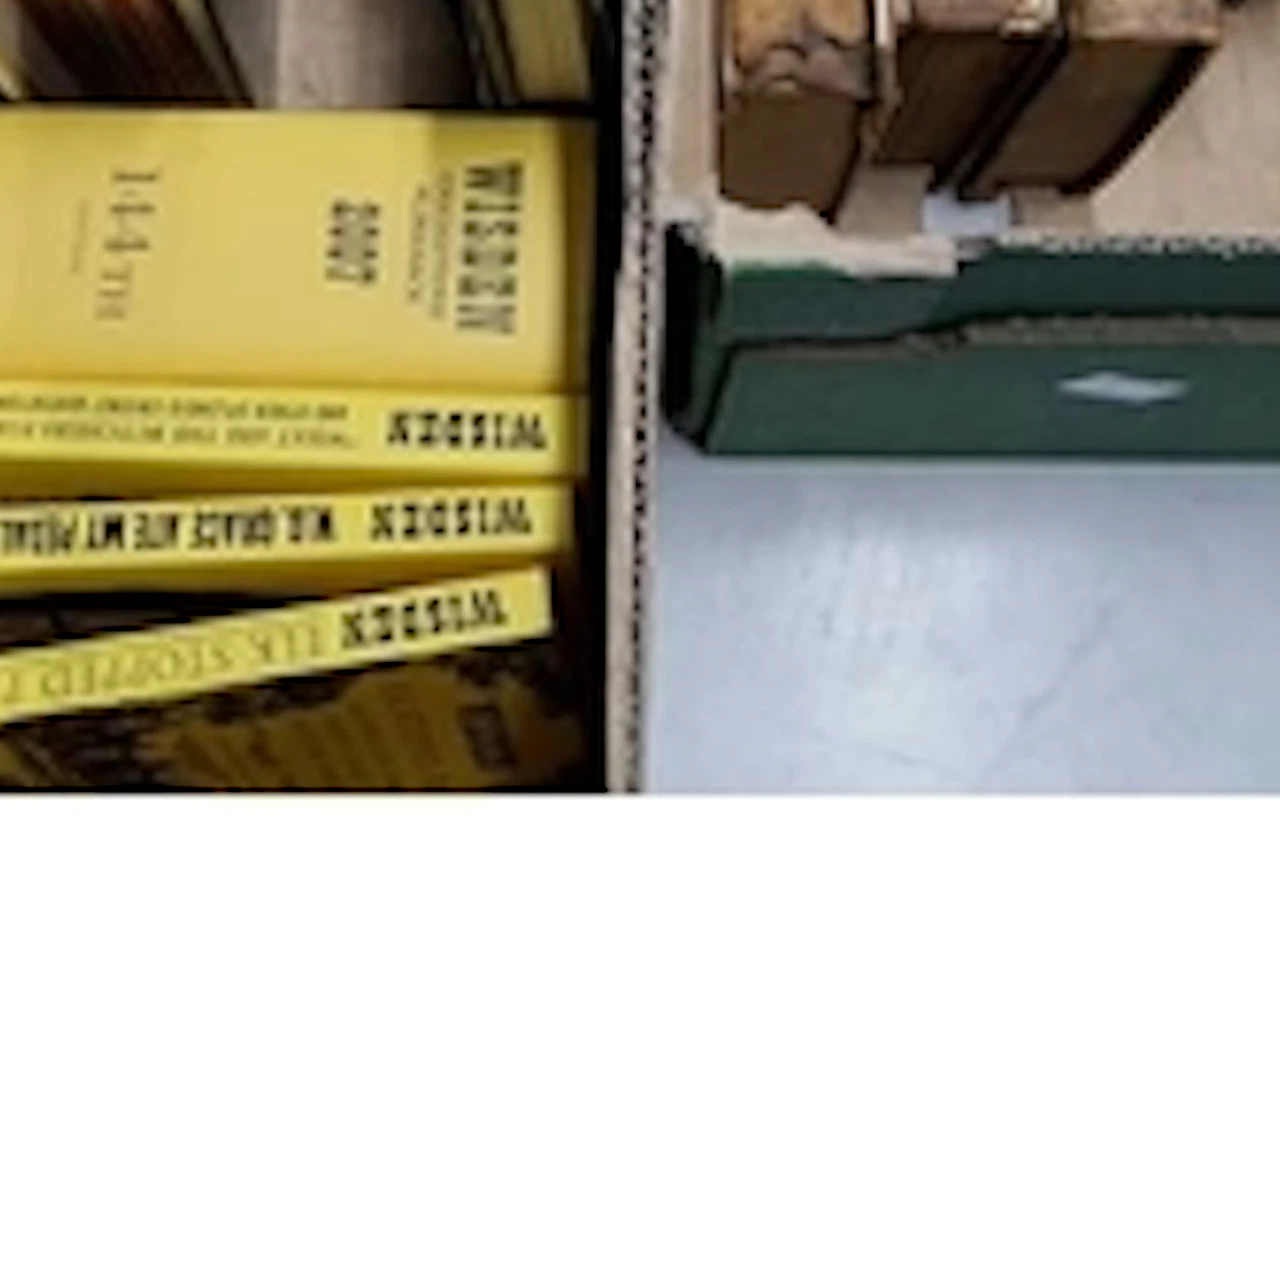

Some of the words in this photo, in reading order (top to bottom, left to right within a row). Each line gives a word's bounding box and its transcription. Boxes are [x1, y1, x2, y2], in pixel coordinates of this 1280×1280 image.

[95, 165, 160, 324] 144TH
[454, 157, 524, 337] WISDEN
[386, 410, 549, 452] WISDEN
[85, 511, 125, 553] MY
[135, 509, 183, 550] ATE
[188, 506, 281, 547] GRACE
[369, 498, 533, 539] WISDEN
[340, 590, 507, 646] WISDEN
[42, 636, 235, 698] STOPPED
